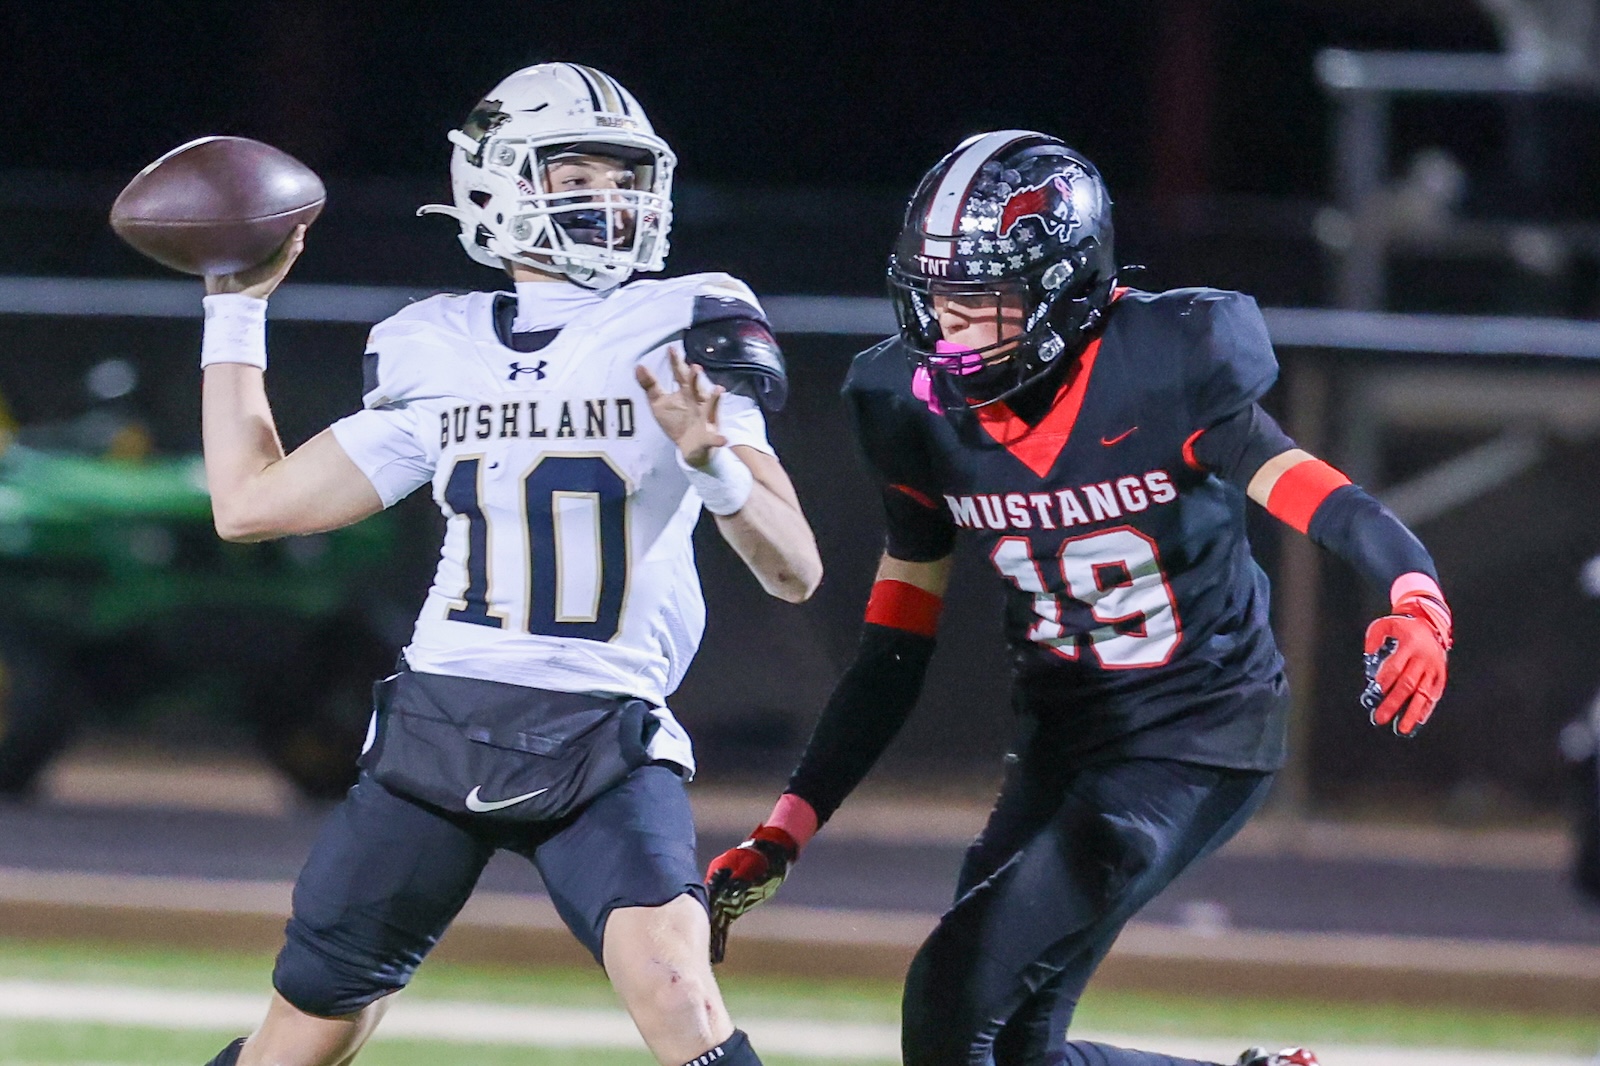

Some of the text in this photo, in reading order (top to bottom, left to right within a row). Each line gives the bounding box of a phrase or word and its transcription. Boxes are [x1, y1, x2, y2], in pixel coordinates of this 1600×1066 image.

[920, 256, 950, 277] TNT
[440, 398, 635, 450] BUSHLAND
[943, 469, 1179, 530] MUSTANGS
[444, 451, 633, 642] 10
[988, 524, 1184, 670] 19
